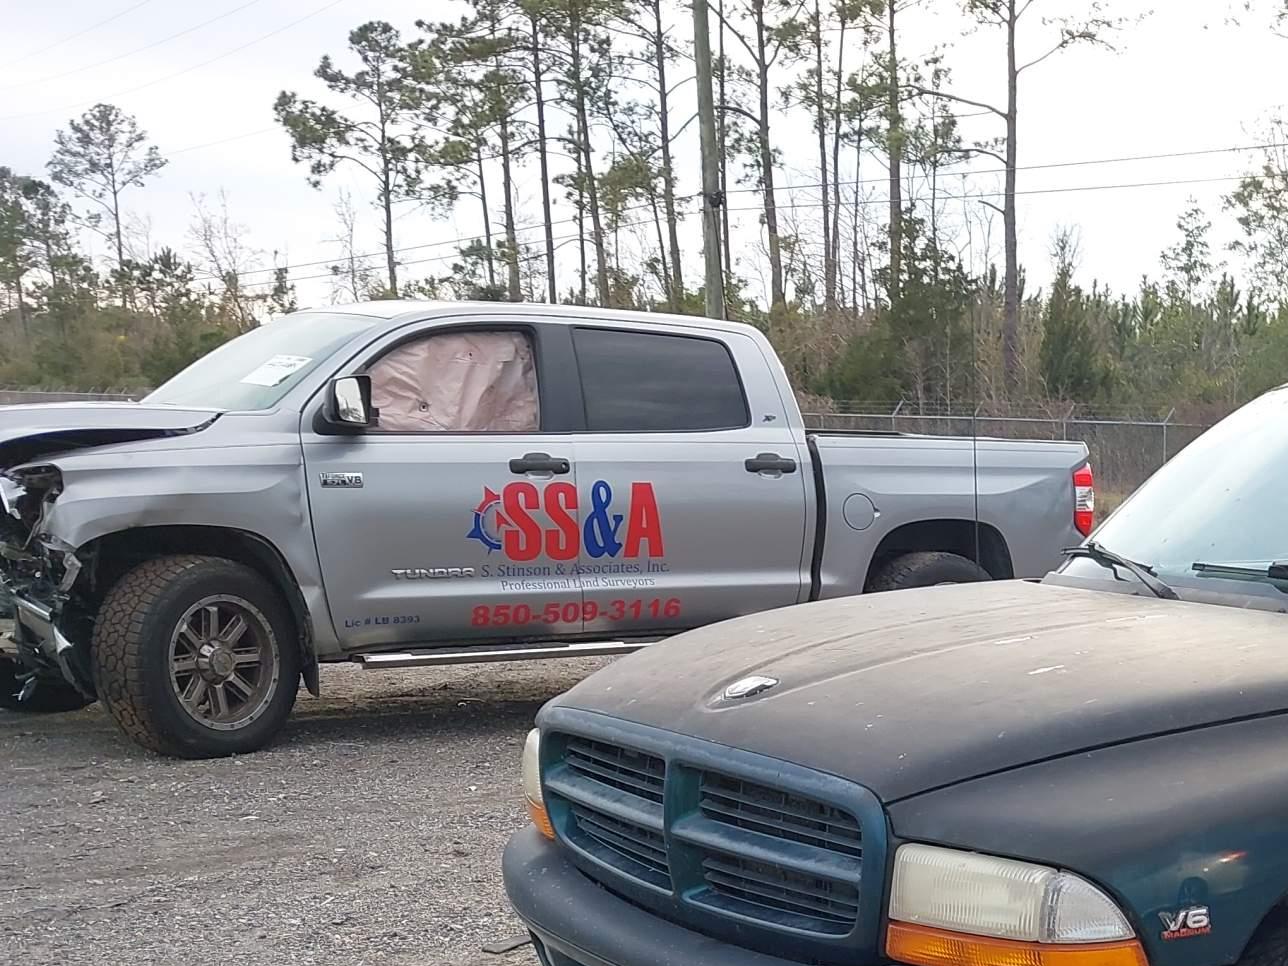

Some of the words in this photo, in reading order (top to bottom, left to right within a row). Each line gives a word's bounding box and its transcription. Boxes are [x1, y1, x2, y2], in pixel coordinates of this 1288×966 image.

[502, 480, 664, 561] SS&A
[391, 566, 476, 579] TUNDRA
[481, 564, 494, 578] S.
[498, 563, 550, 577] Stinson
[555, 563, 567, 576] &
[570, 561, 643, 576] Associates,
[647, 559, 670, 573] Inc.
[501, 579, 570, 591] Professional
[573, 578, 599, 590] Land
[602, 576, 655, 589] Surveyors
[471, 598, 681, 628] 850-509-3116
[344, 619, 361, 628] Lic
[1158, 905, 1211, 932] V6
